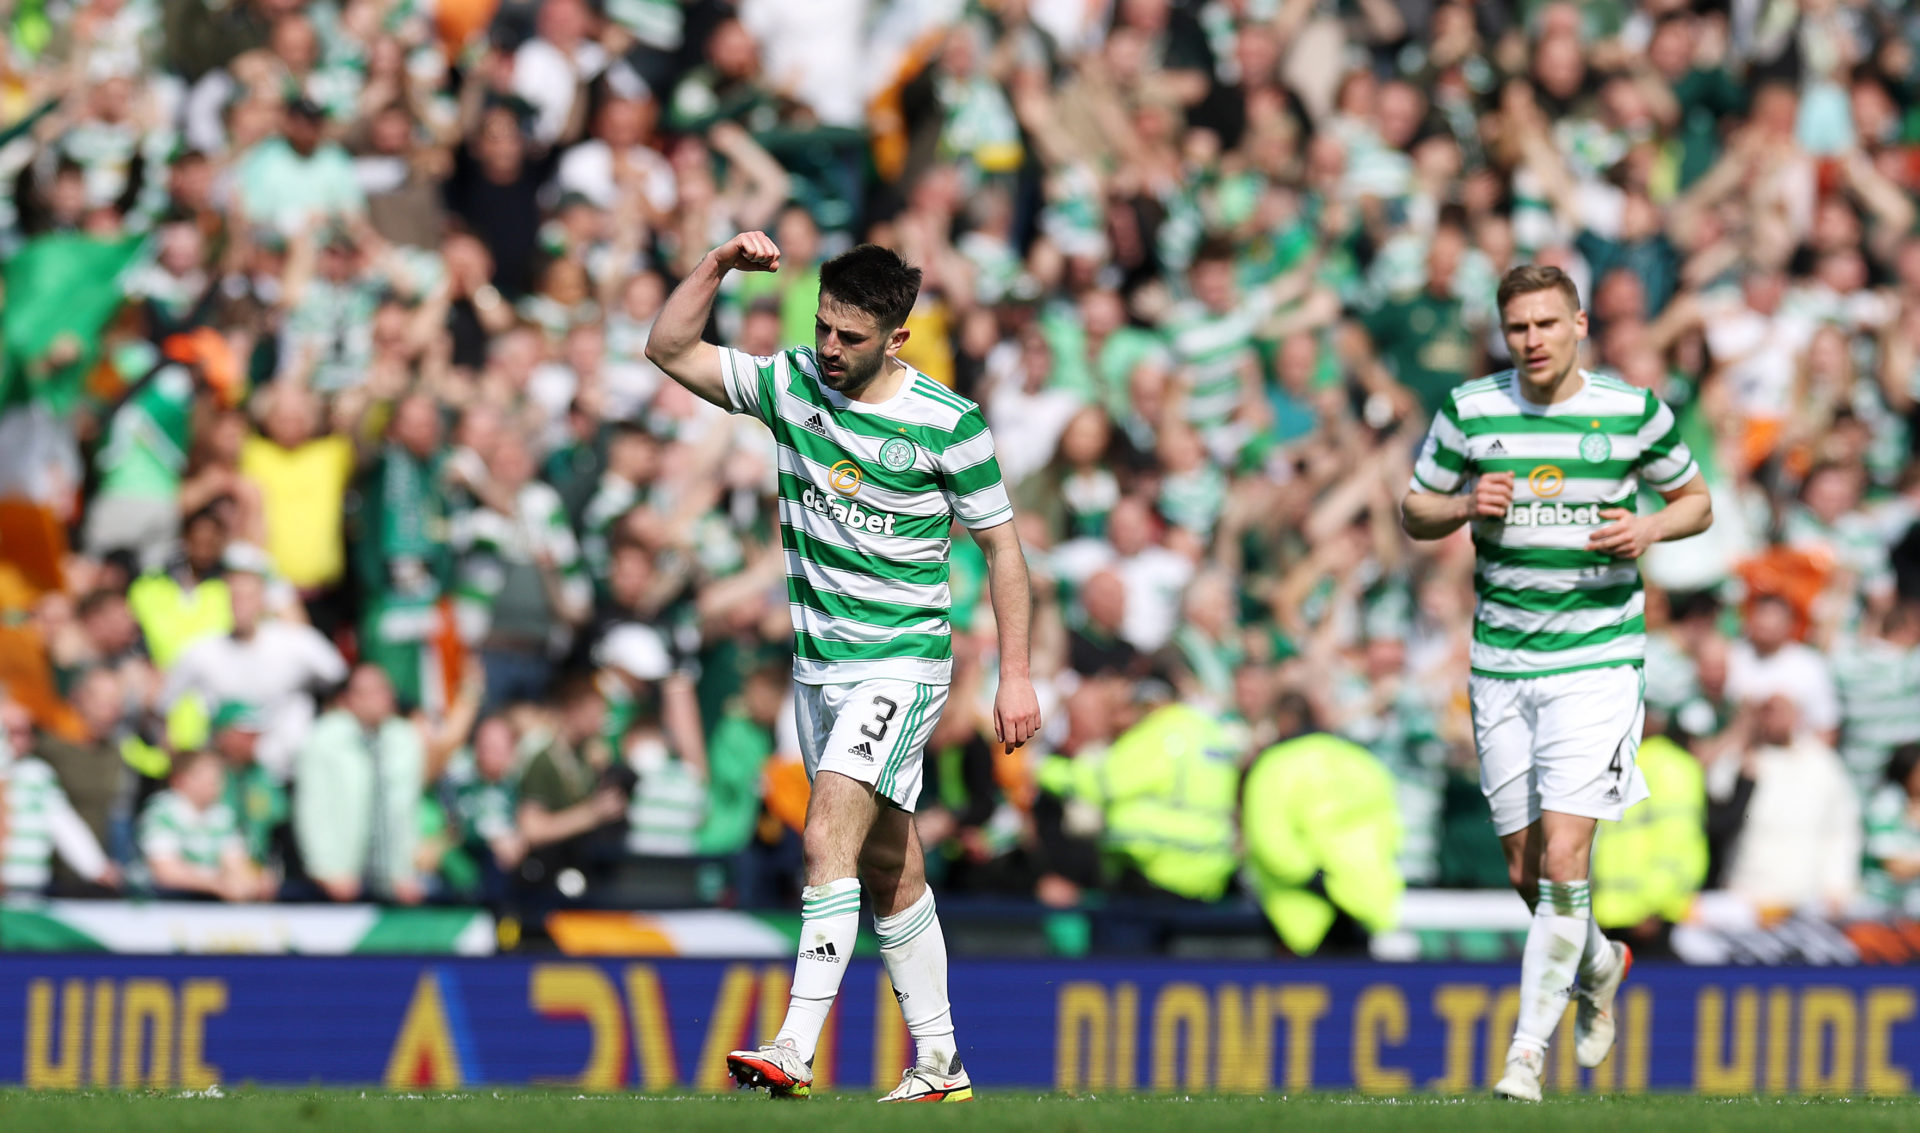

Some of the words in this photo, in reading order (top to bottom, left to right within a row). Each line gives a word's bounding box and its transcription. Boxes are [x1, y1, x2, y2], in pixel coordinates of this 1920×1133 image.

[804, 420, 826, 435] adidas
[802, 485, 897, 536] dafabet
[860, 695, 898, 742] 3
[848, 747, 875, 763] adidas
[1608, 737, 1623, 781] 4
[799, 952, 841, 963] adidas
